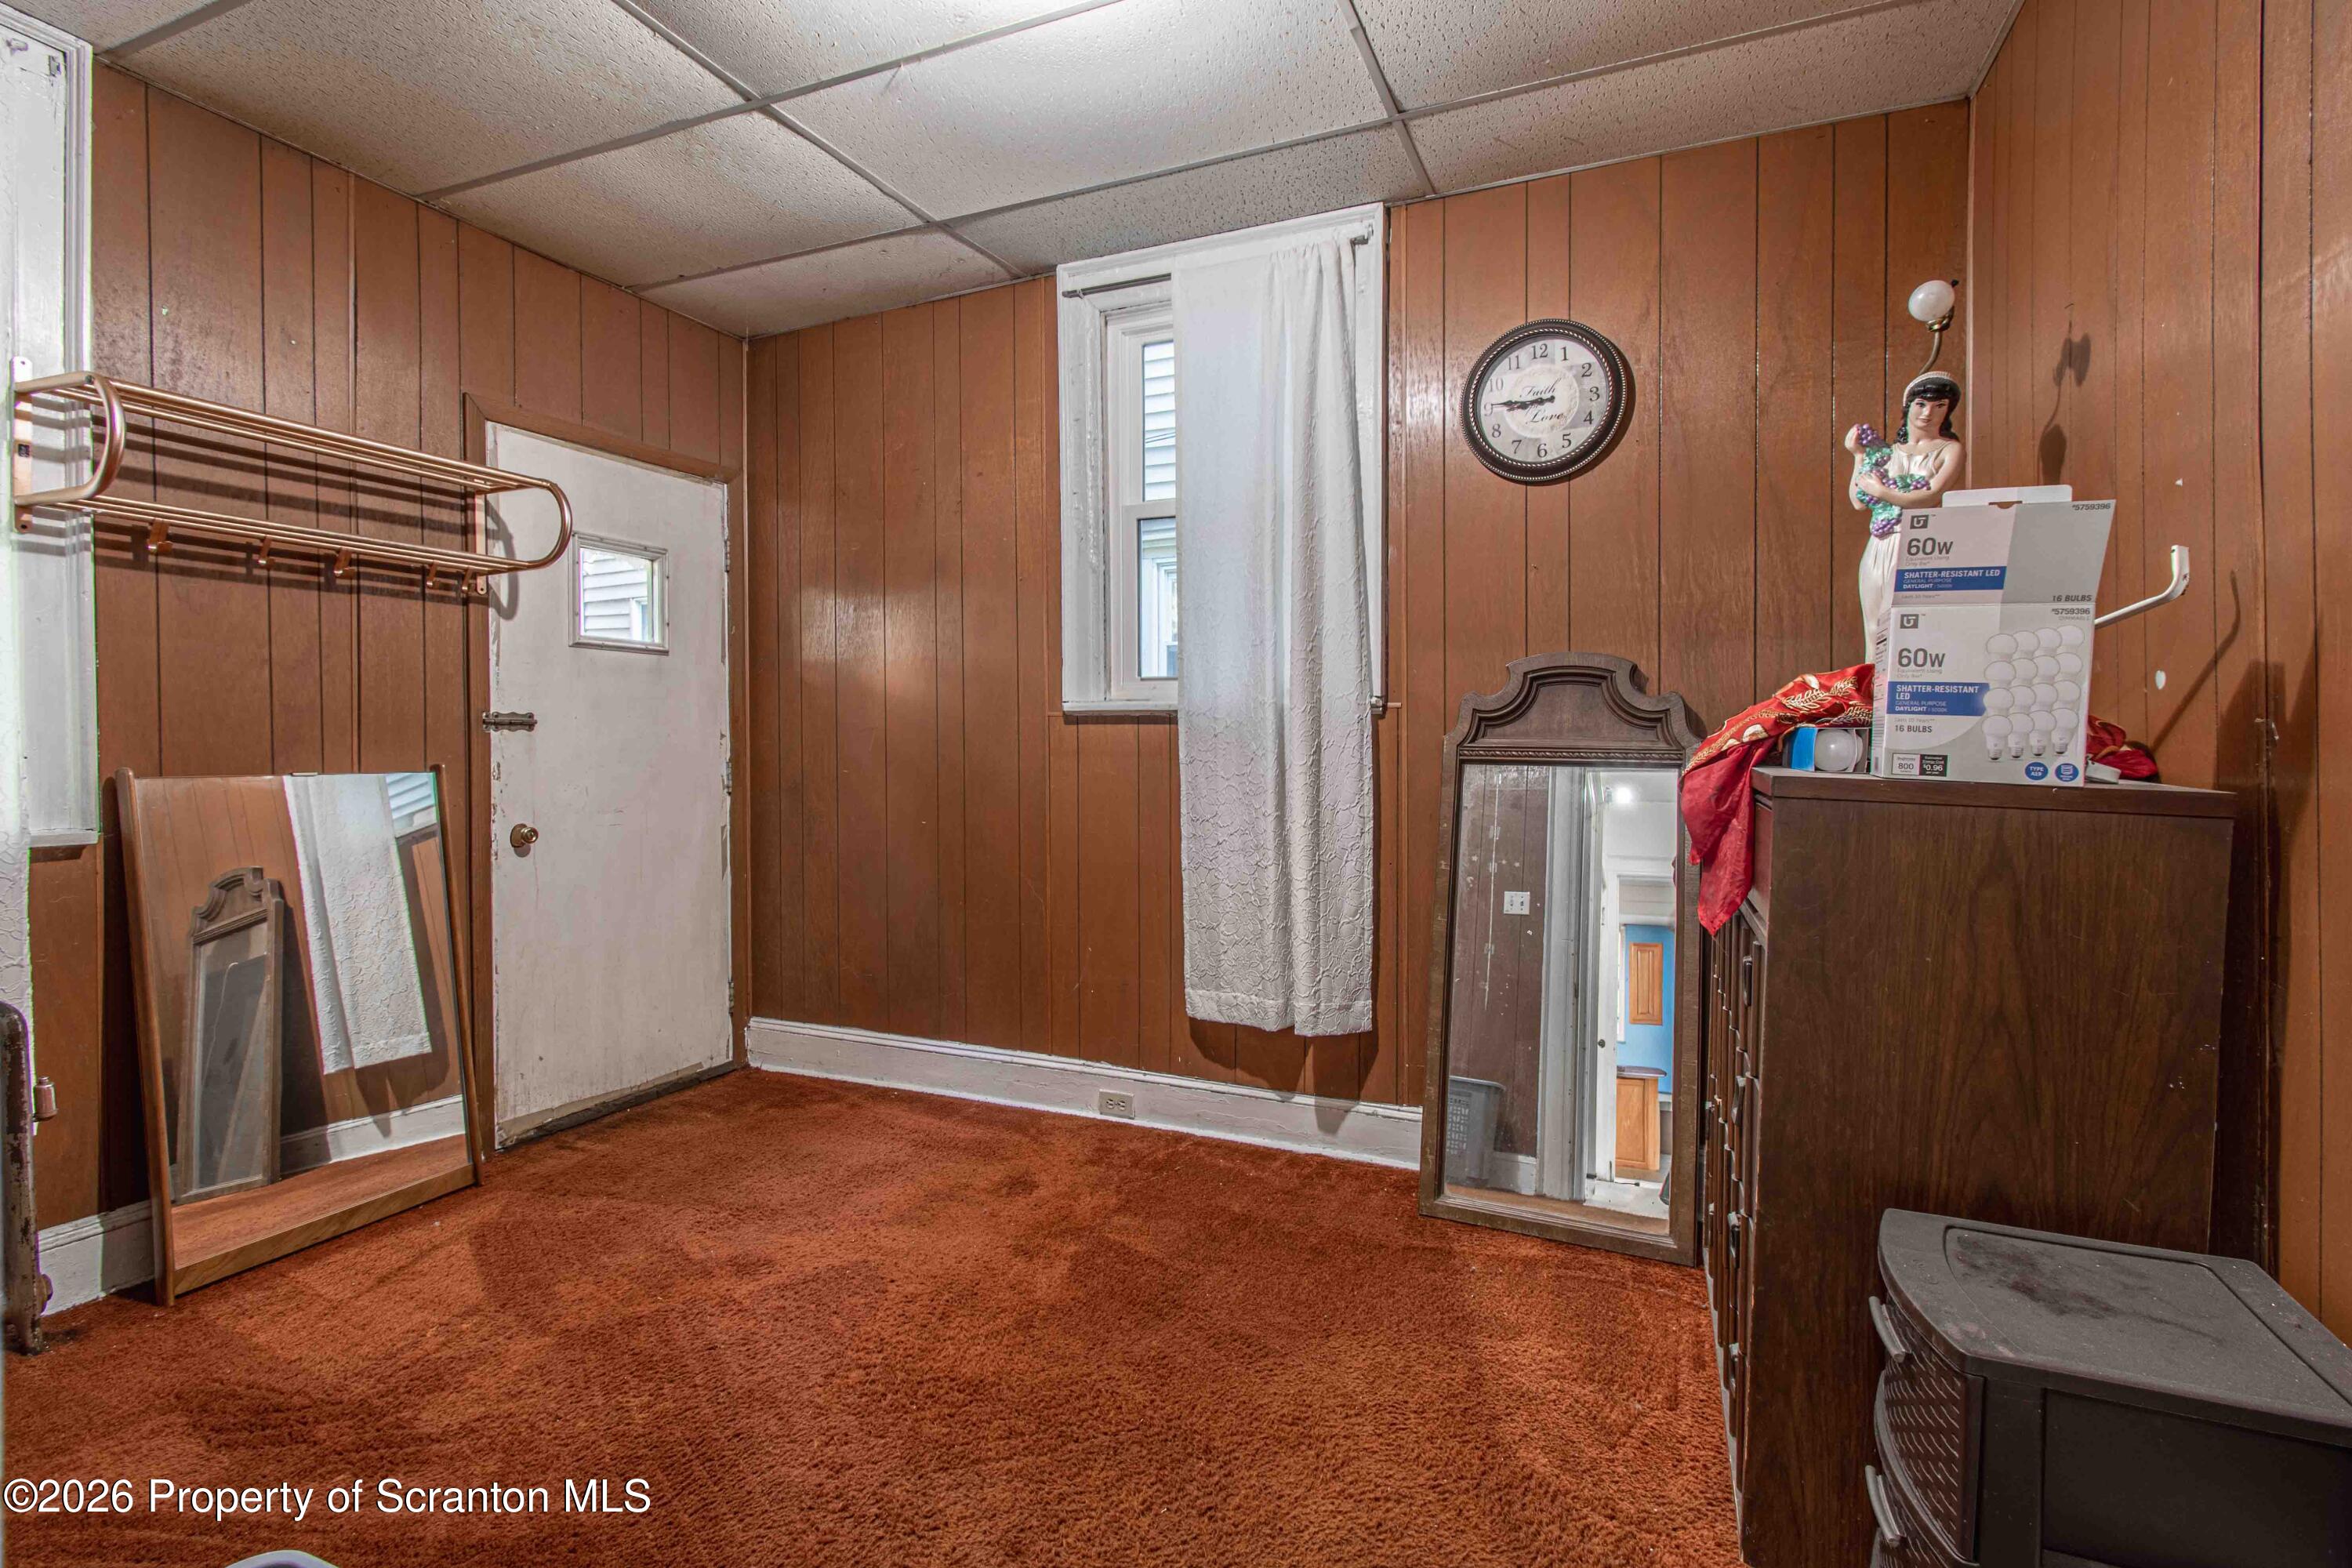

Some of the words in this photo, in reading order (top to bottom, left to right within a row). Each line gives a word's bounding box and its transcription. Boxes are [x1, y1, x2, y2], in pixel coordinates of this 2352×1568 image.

[1532, 343, 1548, 359] 12
[1561, 346, 1569, 361] 1
[1508, 355, 1520, 370] 11
[1581, 362, 1592, 377] 2
[1488, 378, 1504, 392] 10
[1589, 386, 1600, 401] 3
[1483, 403, 1494, 416] 9
[1583, 410, 1594, 425] 4
[1491, 423, 1501, 438] 8
[1512, 439, 1522, 454] 7
[1562, 433, 1572, 448] 5
[1537, 443, 1548, 458] 6
[1904, 569, 1984, 579] SHATTER-RESISTANT
[1896, 684, 1979, 693] SHATTER-RESISTANT
